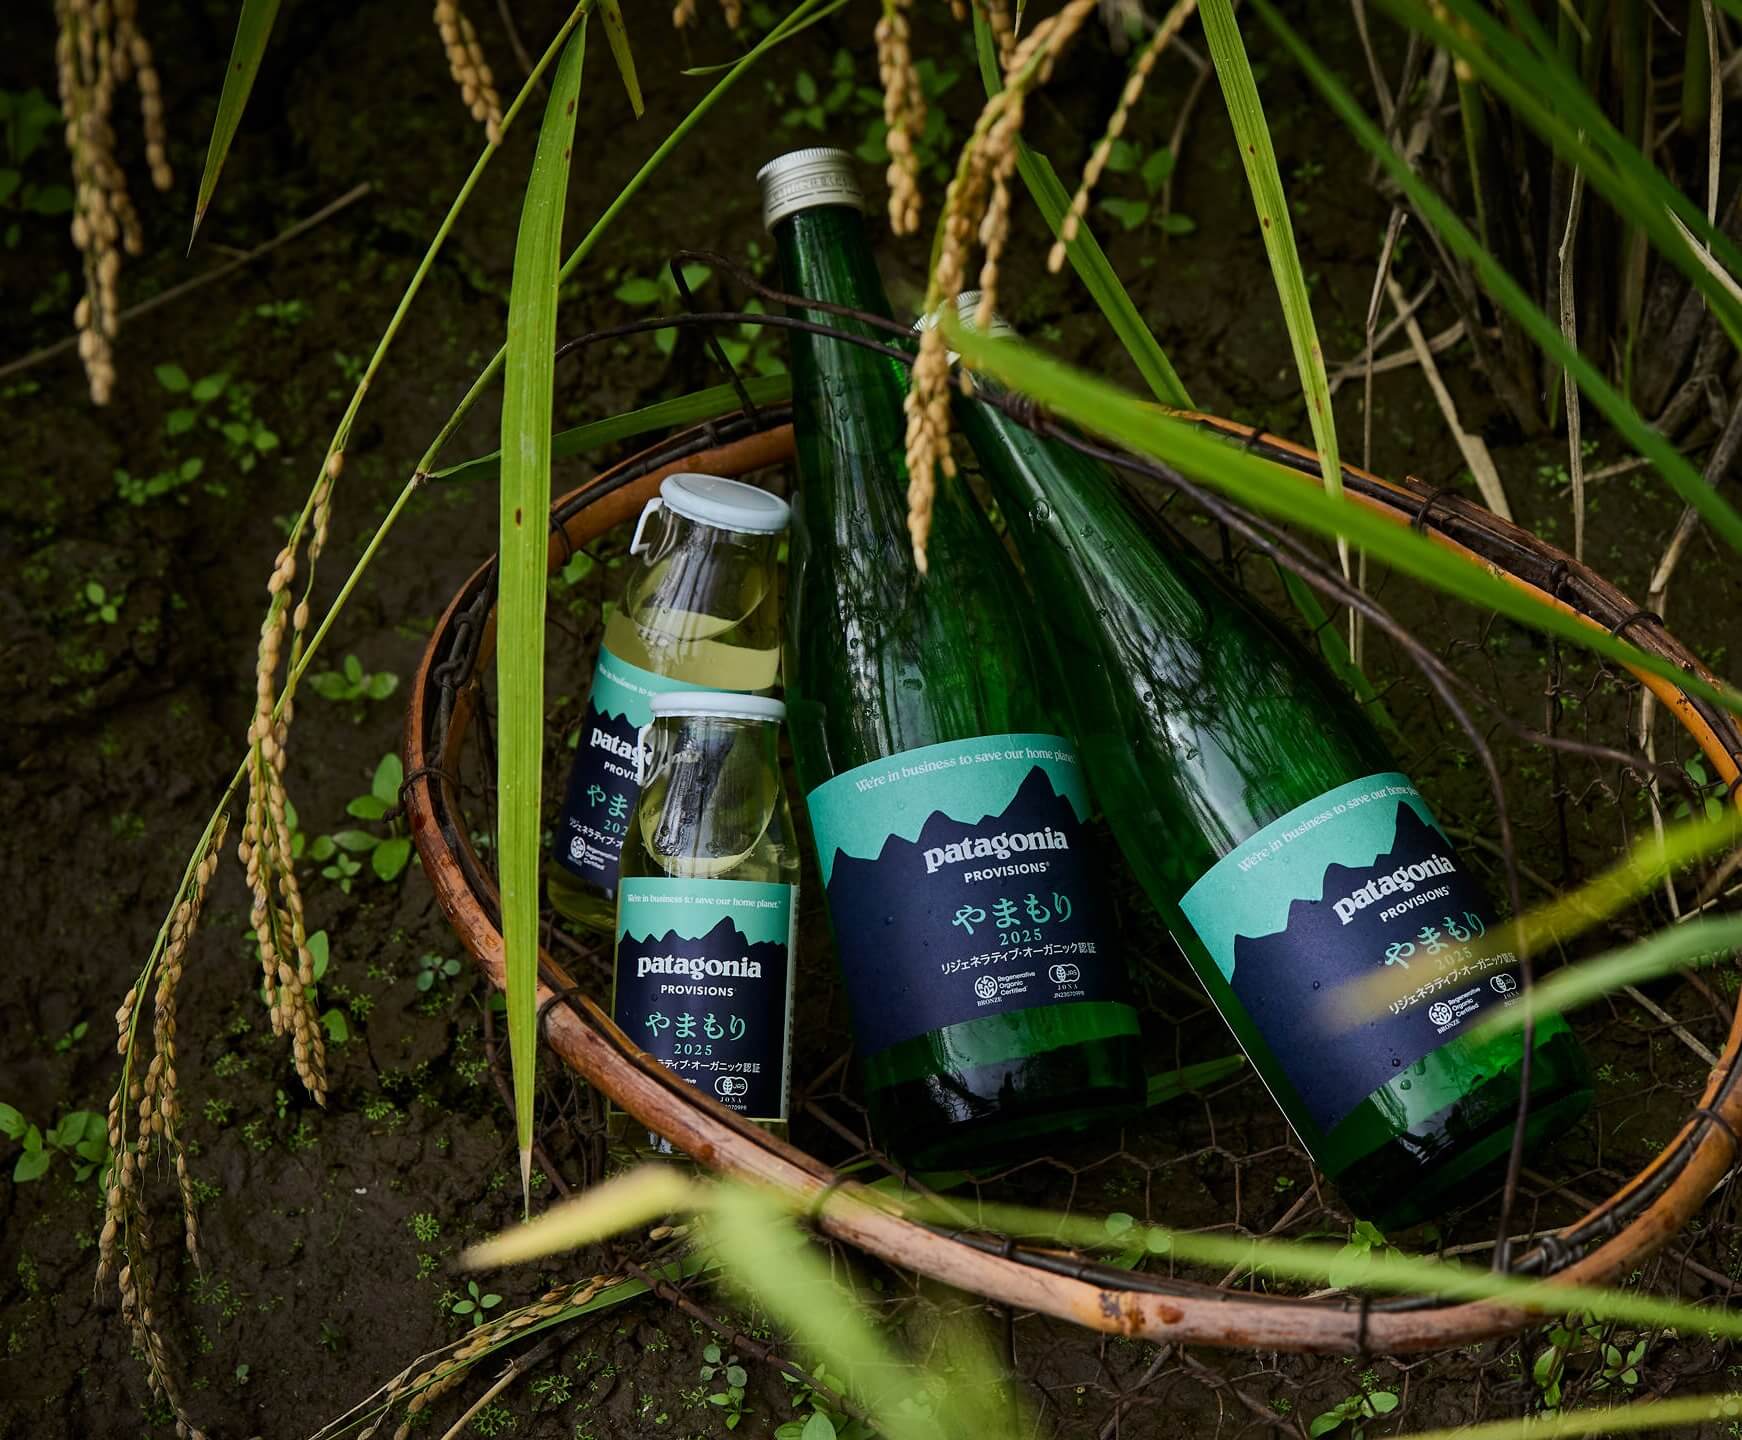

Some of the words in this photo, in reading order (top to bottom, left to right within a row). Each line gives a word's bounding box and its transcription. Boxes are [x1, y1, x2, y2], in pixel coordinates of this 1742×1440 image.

[888, 770, 900, 783] in
[901, 760, 957, 778] business
[959, 755, 973, 766] to
[975, 751, 1003, 764] save
[1004, 749, 1024, 760] our
[1025, 747, 1053, 760] home
[1269, 839, 1283, 852] in
[1282, 812, 1333, 844] business
[1333, 804, 1346, 817] to
[1346, 795, 1371, 809] save
[1371, 790, 1387, 801] our
[923, 826, 1069, 874] patagonia
[650, 895, 682, 904] business
[684, 895, 693, 904] to
[733, 897, 755, 907] home
[1332, 854, 1456, 925] patagonia
[952, 892, 1072, 935] やまもり
[998, 928, 1042, 946] 2025
[1385, 912, 1485, 969] やまもり
[637, 955, 761, 980] patagonia
[1434, 946, 1473, 970] 2025
[997, 971, 1036, 982] Regenerative
[998, 980, 1023, 989] Organic
[1451, 998, 1473, 1011] Organic
[645, 1011, 747, 1041] やまもり
[1437, 1018, 1461, 1034] BRONZE
[674, 1043, 713, 1056] 2025
